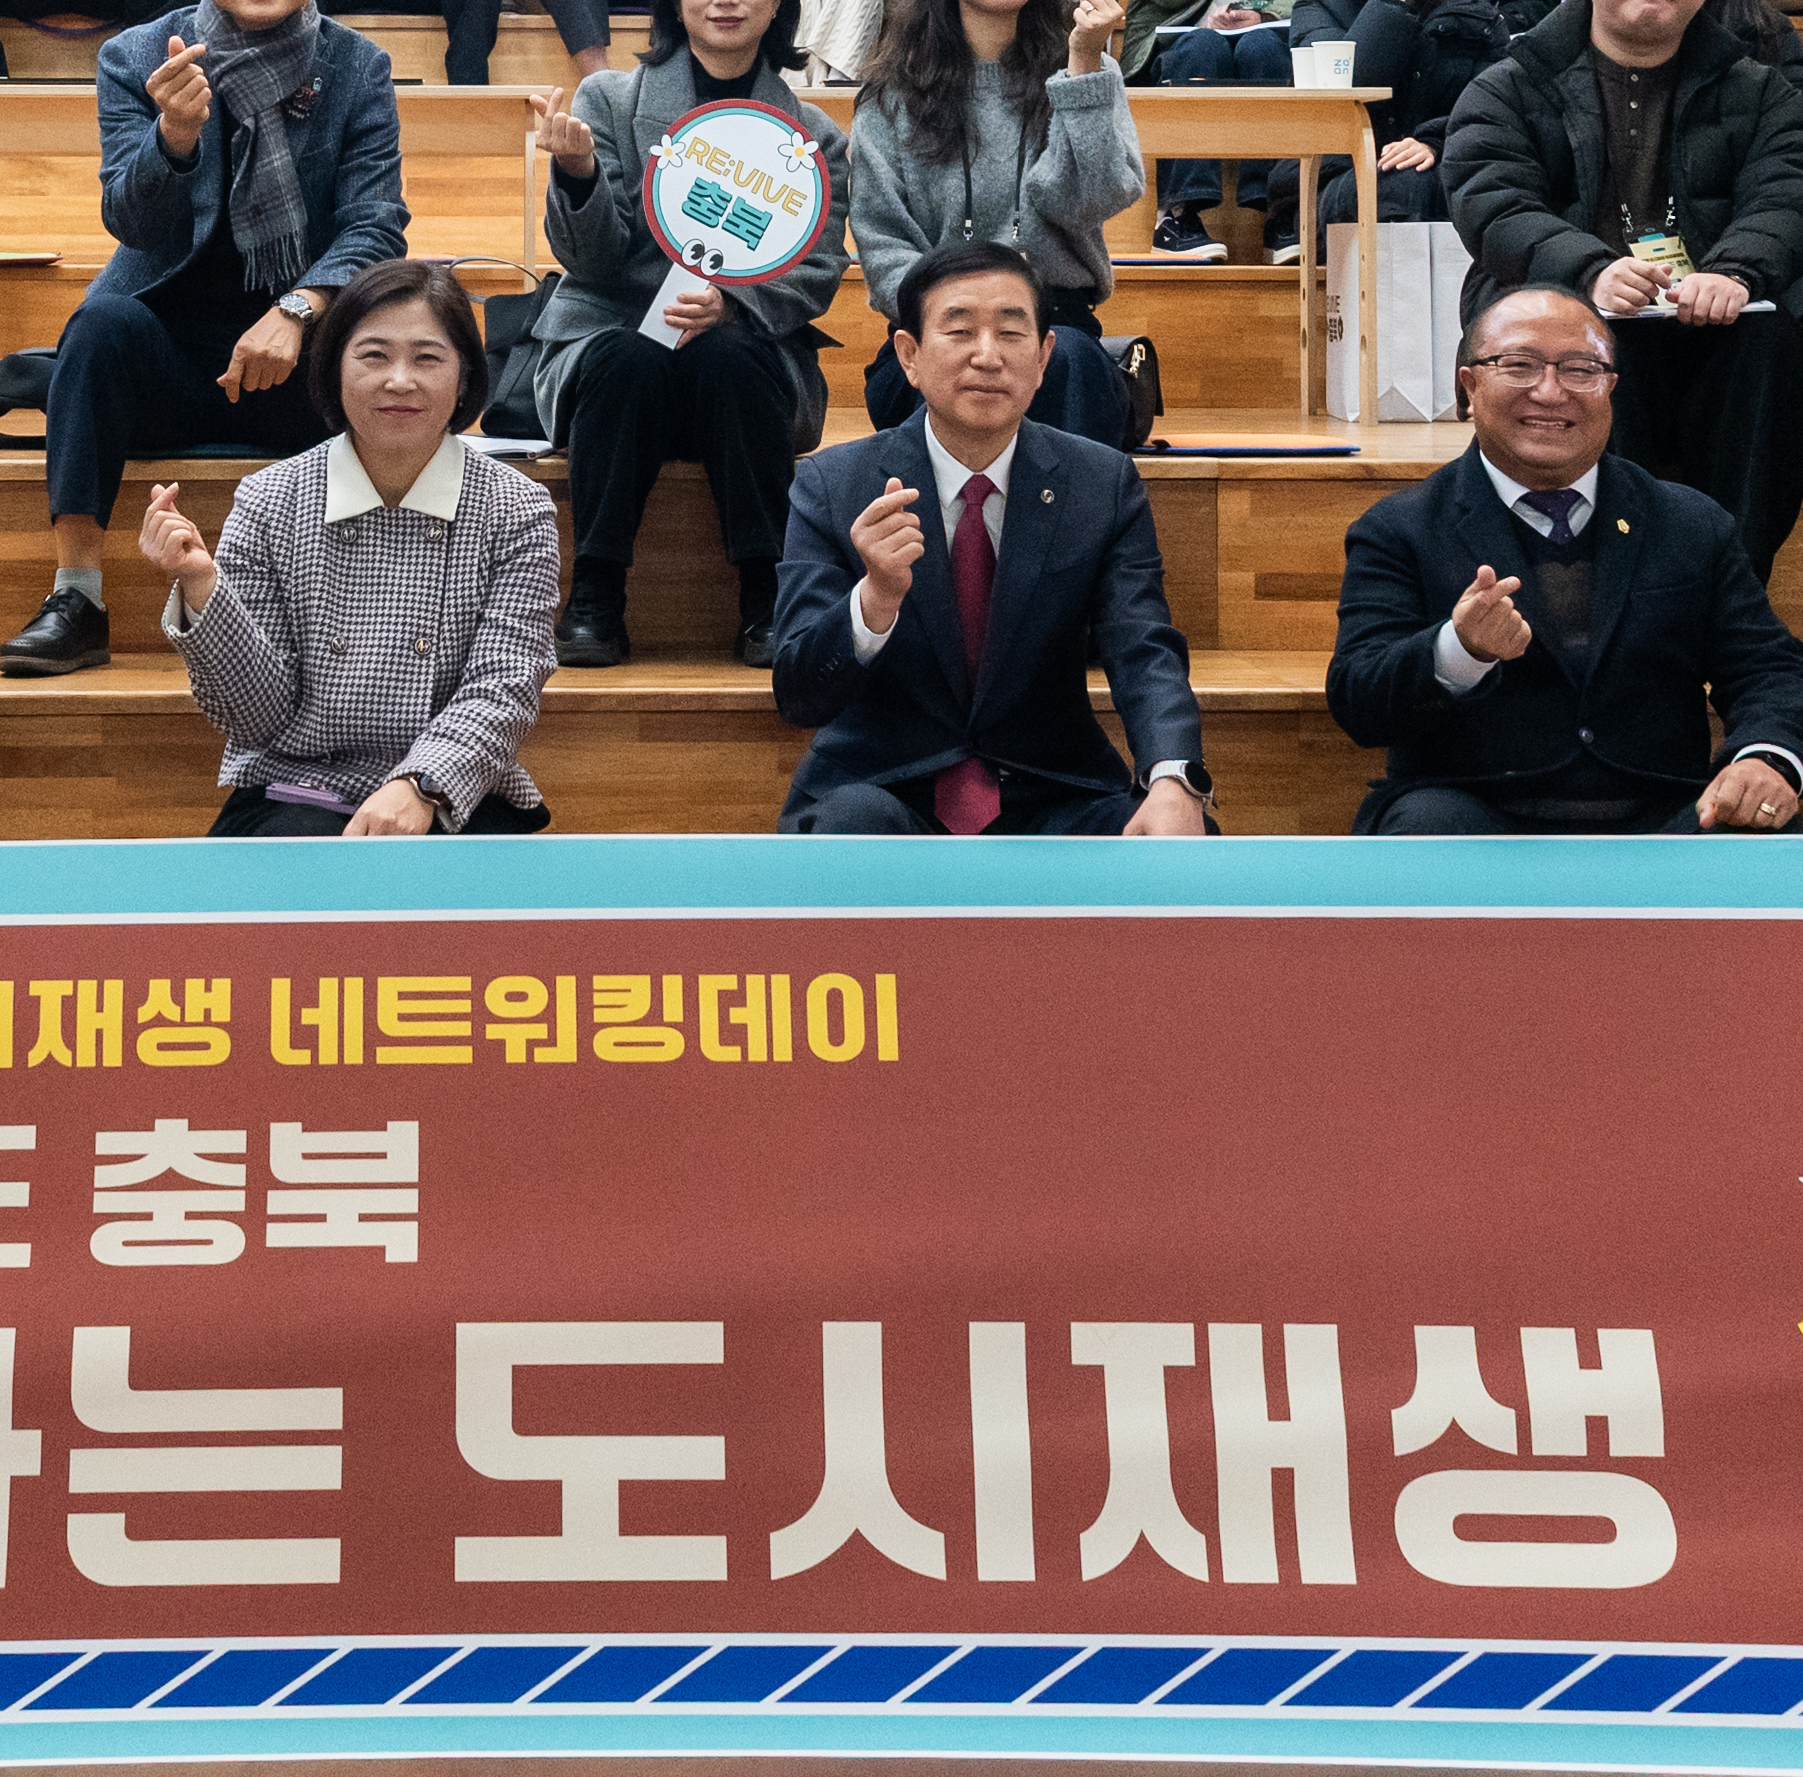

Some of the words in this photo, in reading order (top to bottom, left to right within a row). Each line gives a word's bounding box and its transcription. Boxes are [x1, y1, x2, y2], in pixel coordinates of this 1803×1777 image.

[681, 176, 773, 252] 충북
[270, 973, 899, 1065] 네트워킹데이
[90, 1118, 420, 1267] 충북
[454, 1321, 1678, 1589] 도시재생
